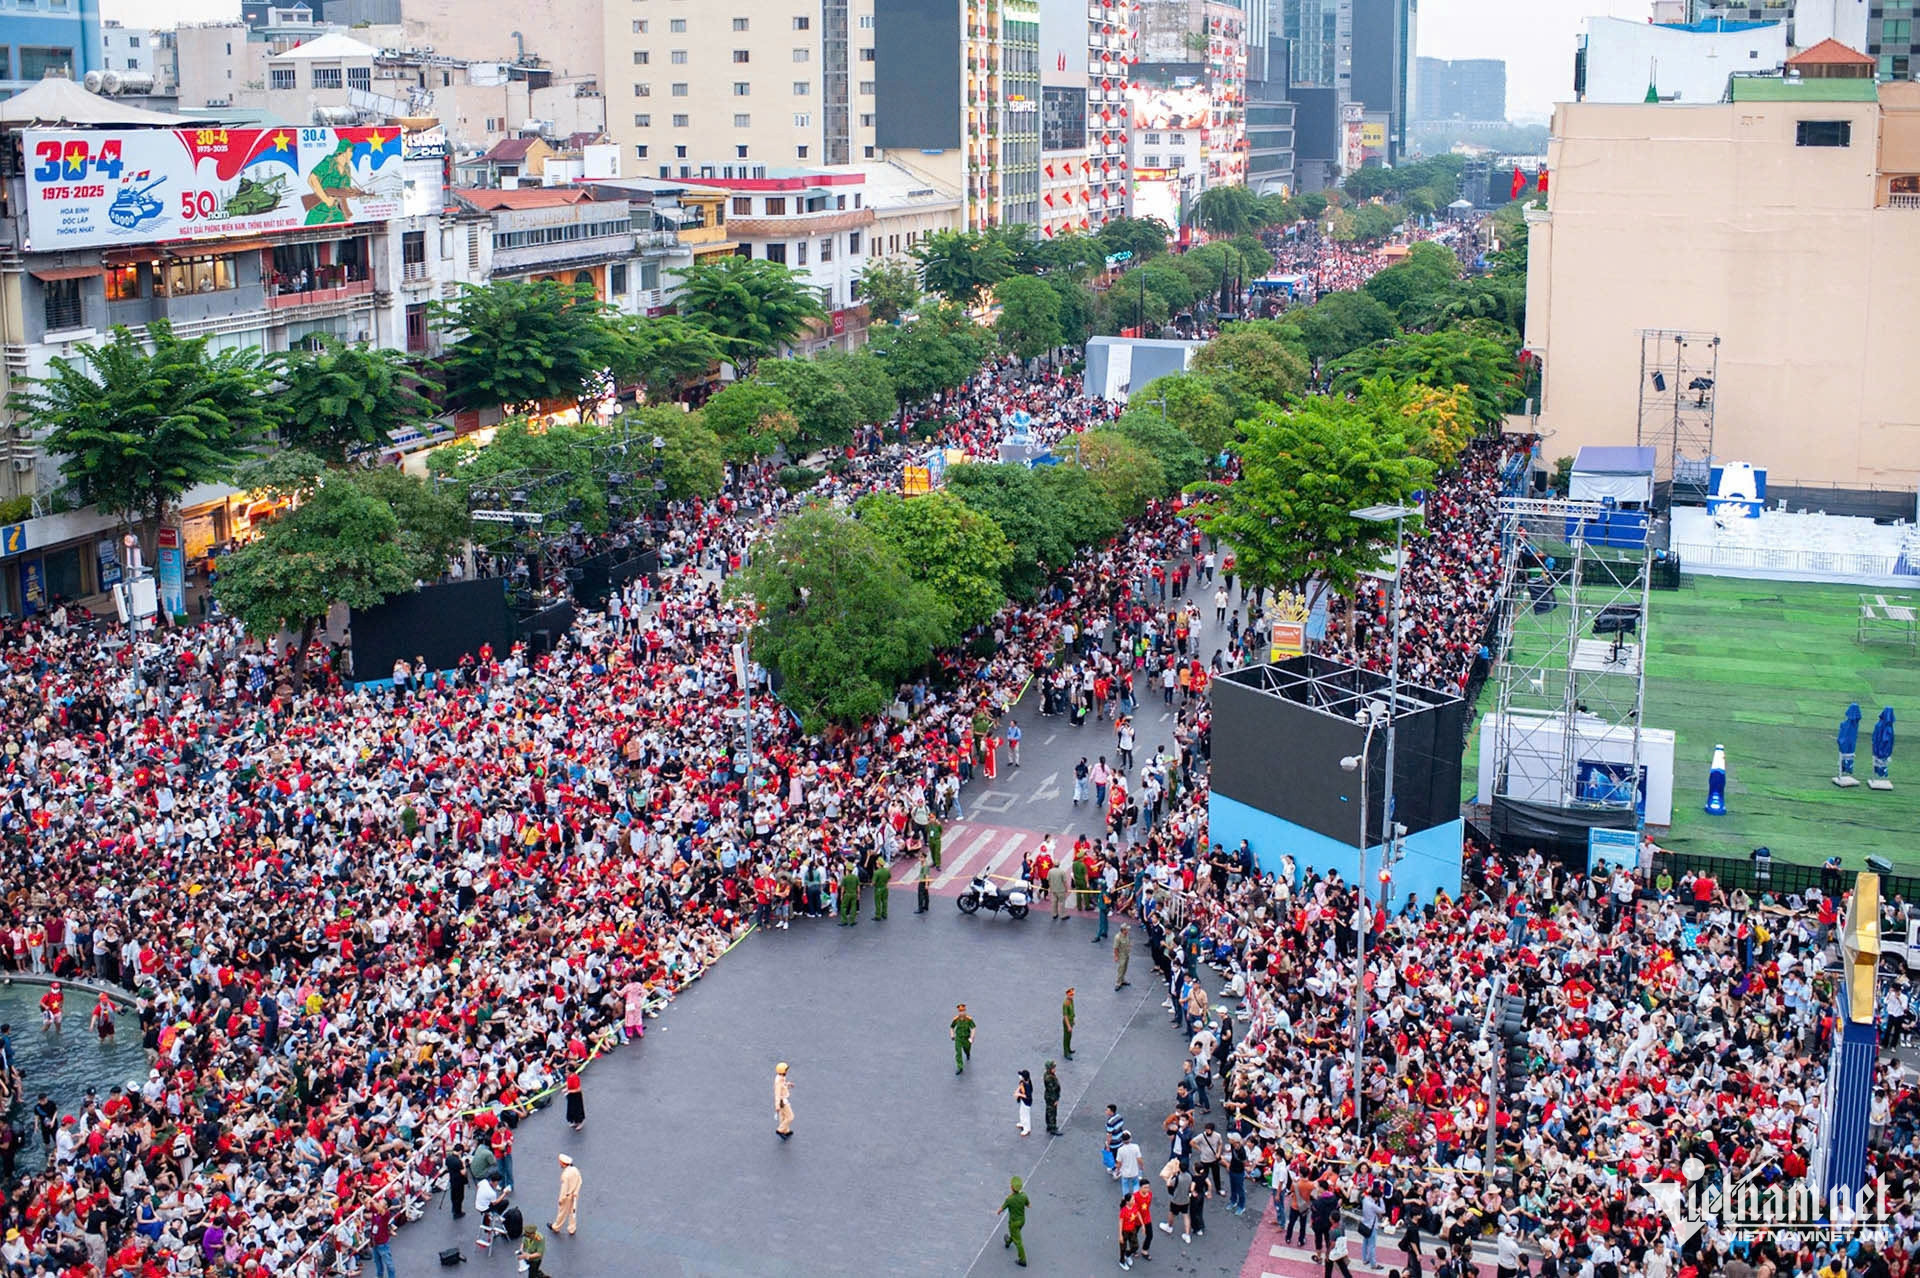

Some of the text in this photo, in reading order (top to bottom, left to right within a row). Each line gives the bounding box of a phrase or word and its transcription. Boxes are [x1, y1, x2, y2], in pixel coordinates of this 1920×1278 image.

[196, 130, 229, 145] 30-4
[303, 129, 327, 141] 30.4
[34, 139, 124, 182] 30-4
[181, 188, 218, 221] 50
